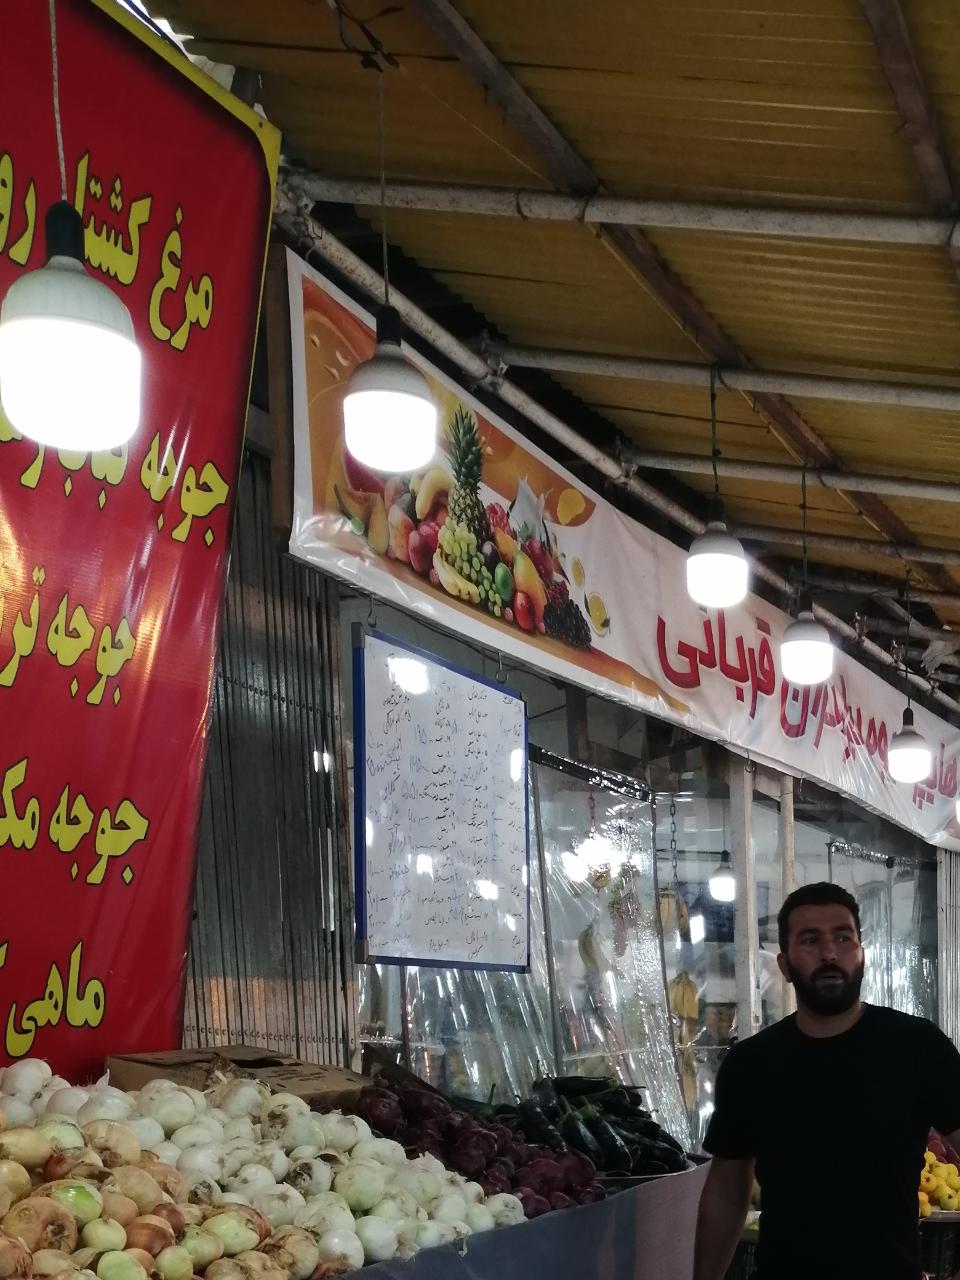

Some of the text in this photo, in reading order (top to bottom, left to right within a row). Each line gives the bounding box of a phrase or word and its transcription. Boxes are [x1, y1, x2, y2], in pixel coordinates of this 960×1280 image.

[74, 150, 153, 286] کشتا
[149, 205, 214, 351] مرغ
[140, 431, 230, 547] جوجه
[46, 591, 137, 706] جوجه
[656, 607, 774, 720] قربانی
[48, 781, 152, 886] جوجه
[5, 940, 106, 1058] ماهی
